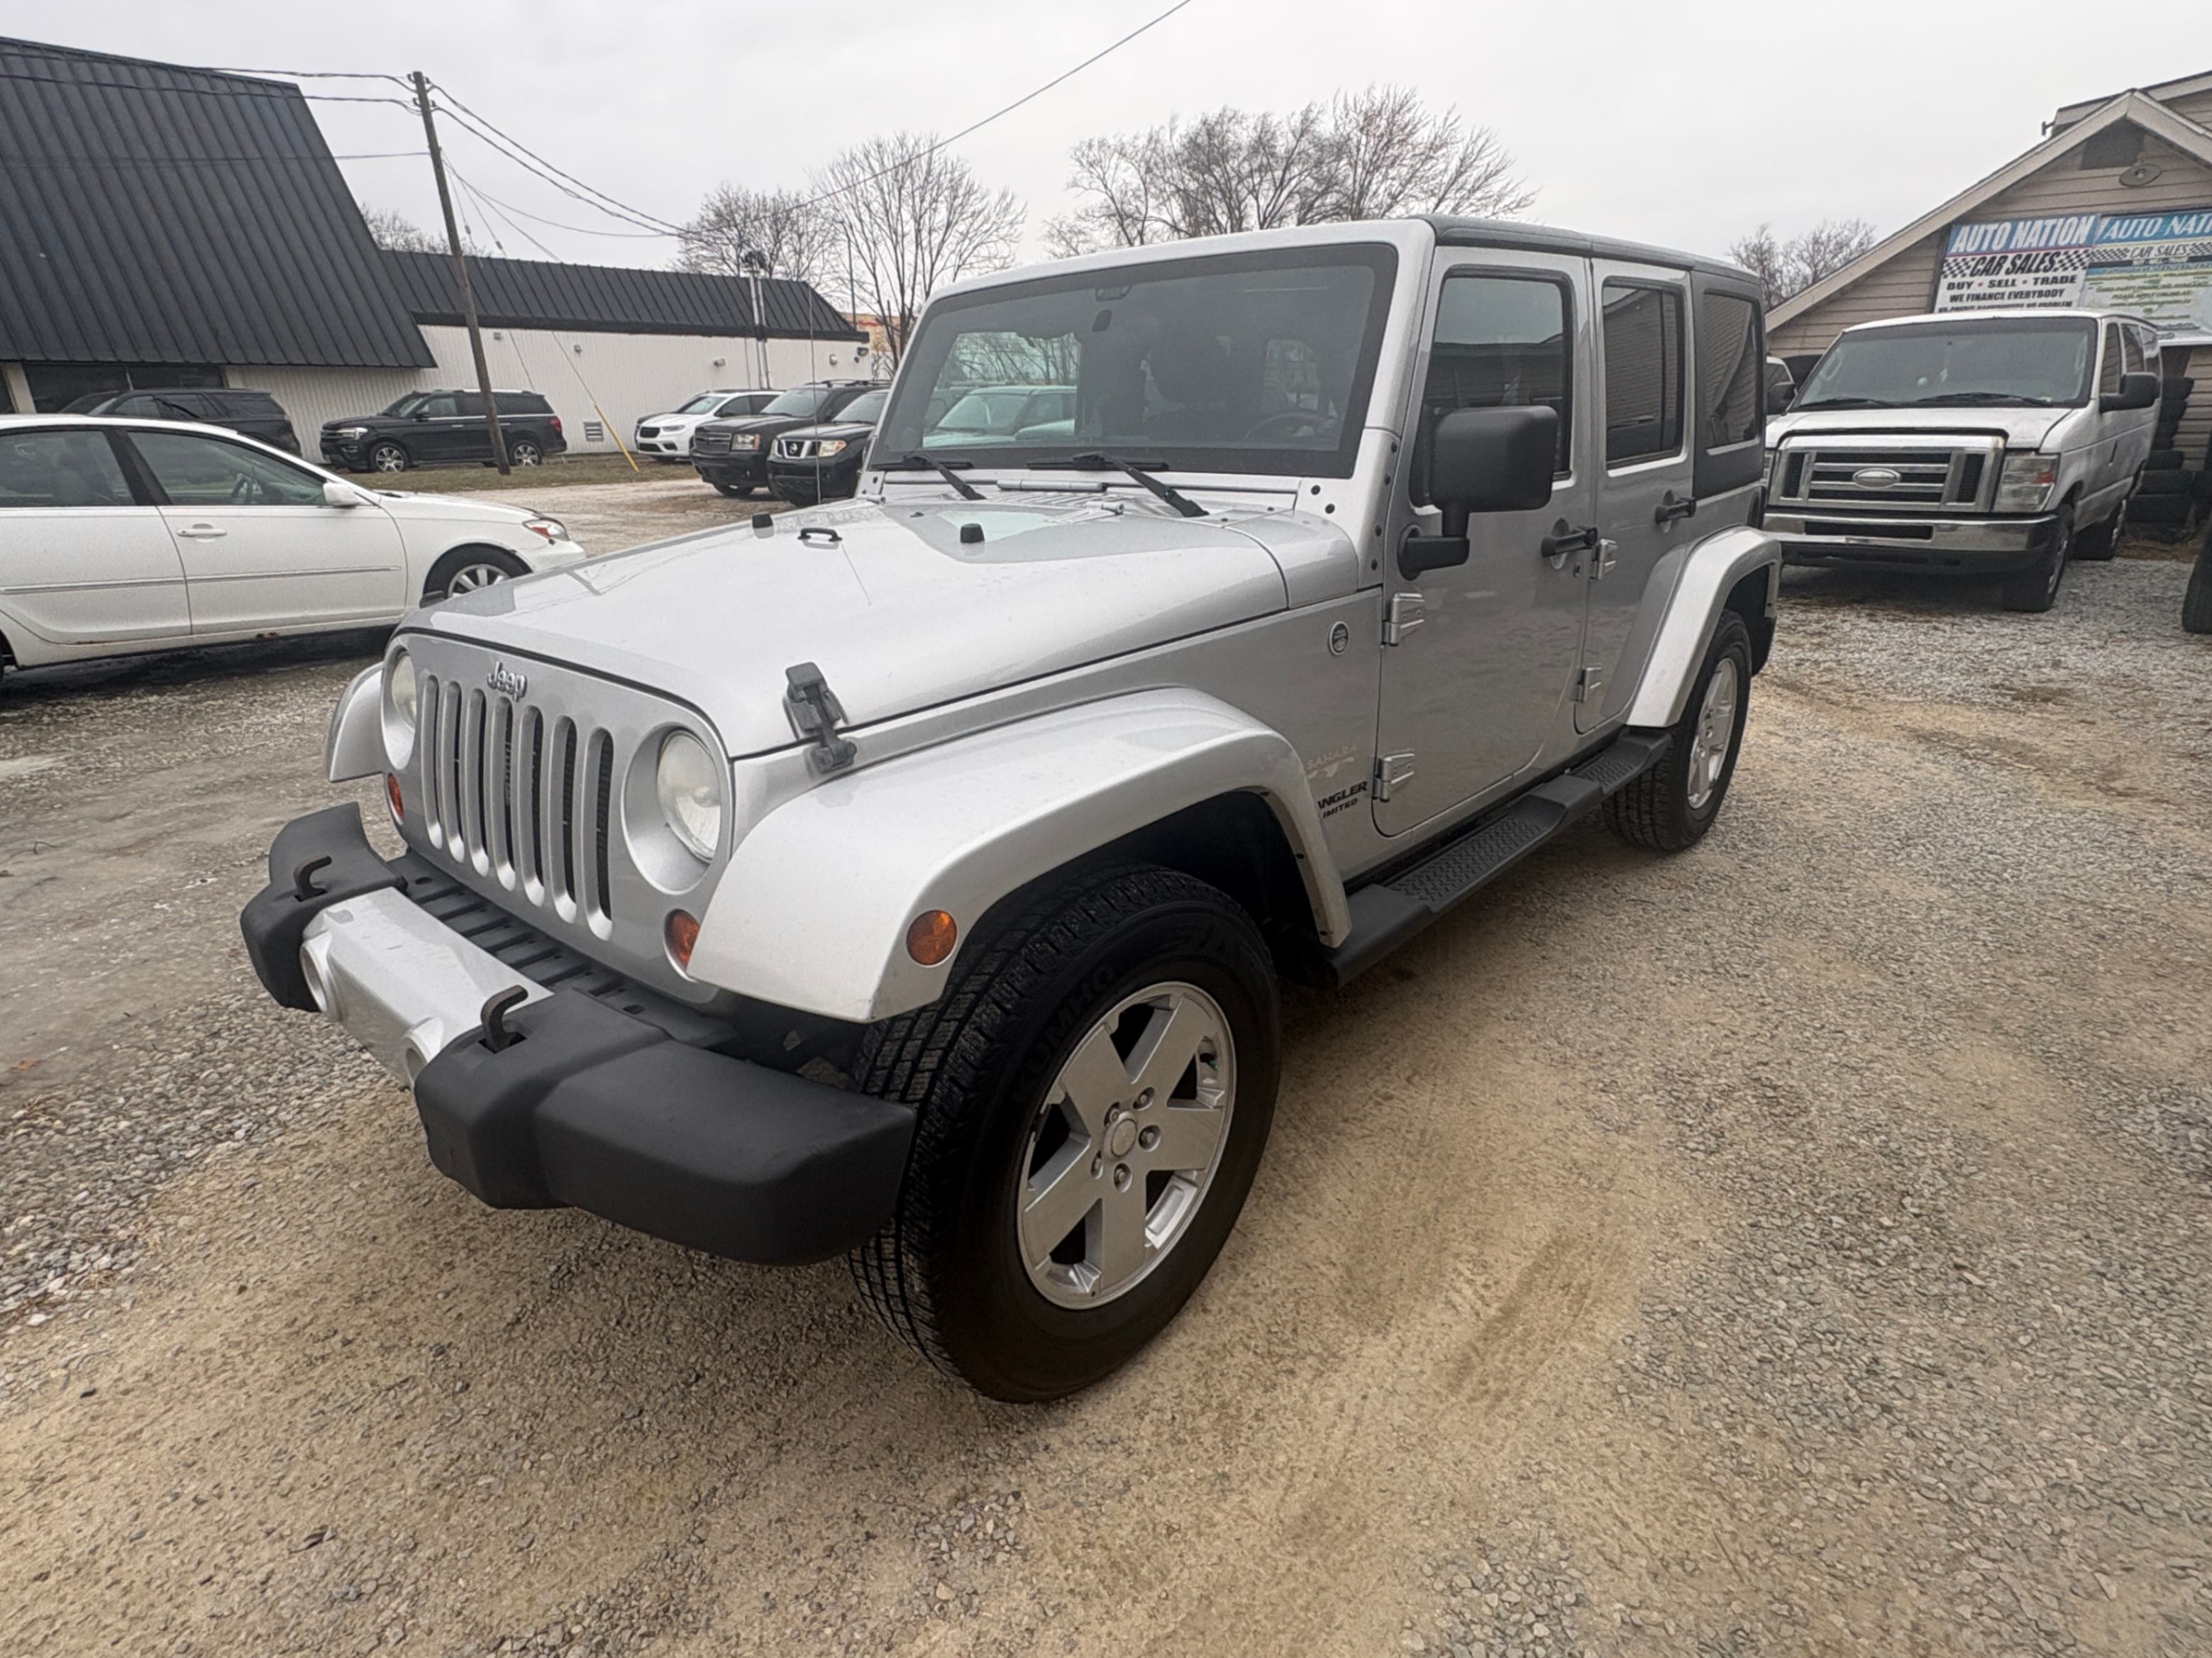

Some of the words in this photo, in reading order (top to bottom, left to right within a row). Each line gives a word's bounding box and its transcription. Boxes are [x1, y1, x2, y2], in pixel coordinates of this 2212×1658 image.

[1950, 221, 2012, 253] AUTO
[2008, 214, 2096, 249] NATION
[2102, 216, 2163, 240] AUTO
[2164, 214, 2212, 236] NATI
[2130, 245, 2155, 258] CAR
[2155, 243, 2190, 258] SALES
[1969, 255, 2008, 277] CAR
[2006, 251, 2061, 275] SALES
[1947, 281, 1974, 291] BUY
[1987, 278, 2017, 288] SELL
[2033, 275, 2077, 285] TRADE
[1950, 294, 1964, 303] WE
[1966, 291, 2005, 302] FINANCE
[2008, 288, 2065, 300] EVERYBODY
[487, 661, 527, 702] Jeep
